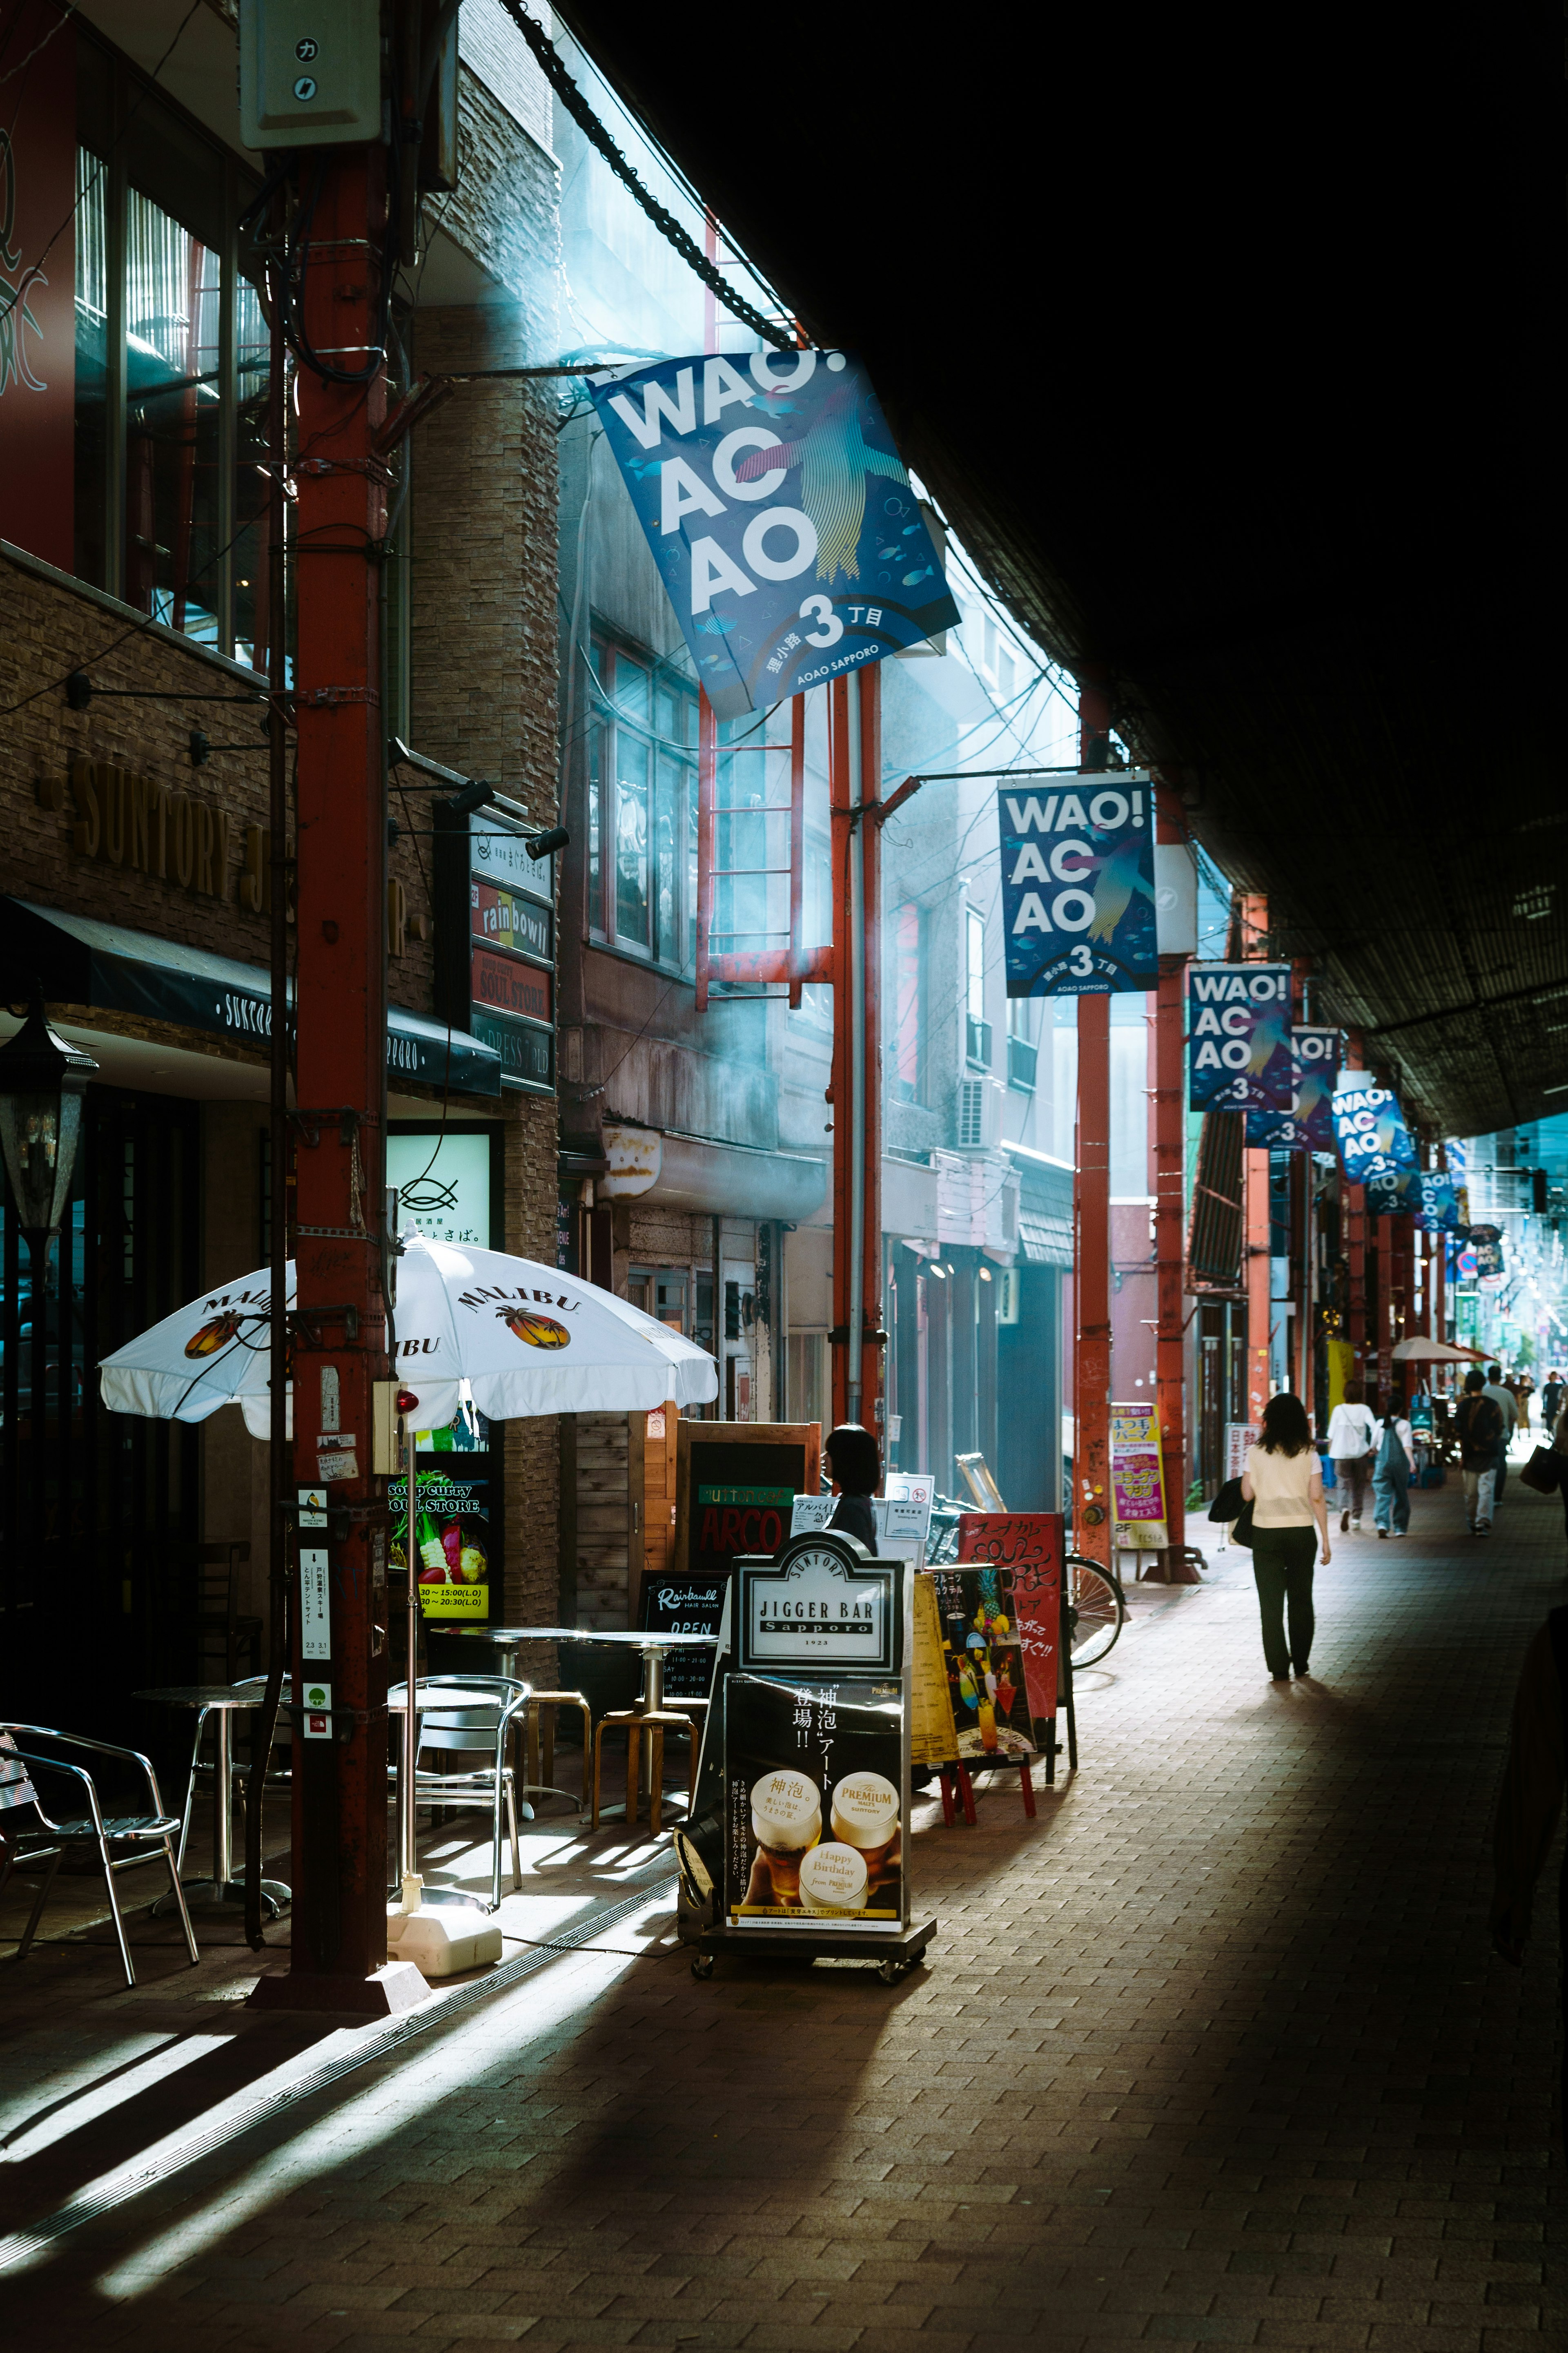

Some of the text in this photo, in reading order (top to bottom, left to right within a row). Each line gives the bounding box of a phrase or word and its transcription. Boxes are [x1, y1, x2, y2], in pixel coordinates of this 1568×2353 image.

[691, 506, 818, 616] AO
[797, 644, 879, 685] AOAO SAPPORO
[1005, 791, 1144, 834] WAO!
[74, 756, 231, 901] SUNTORY
[1012, 889, 1096, 934] AO
[481, 970, 544, 1016] SOUL STORE
[1194, 975, 1287, 1002] WAO!
[226, 993, 417, 1071] SUNTOR PPORO
[1194, 1039, 1251, 1070] AO
[1345, 1131, 1382, 1159] AO
[1369, 1175, 1399, 1192] AO
[418, 1229, 478, 1242] とさば。
[458, 1286, 582, 1314] MALIBU
[395, 1337, 441, 1359] IBU
[427, 1485, 472, 1499] curry
[757, 1489, 791, 1505] caf
[425, 1499, 480, 1512] STORE
[699, 1507, 782, 1554] ARCO
[1115, 1523, 1138, 1532] 2F
[970, 1537, 1043, 1563] SOUL
[791, 1554, 843, 1579] SUNTORY
[933, 1574, 962, 1584] フルーツ
[440, 1589, 481, 1598] 15:00(L.O)
[934, 1586, 963, 1595] カクテル
[440, 1599, 481, 1607] 20:30(L.O)
[760, 1601, 872, 1618] JIGGER BAR
[670, 1620, 711, 1634] OPEN
[765, 1621, 868, 1633] Sapporo
[769, 1777, 810, 1802] 神泡。
[842, 1787, 892, 1804] PREMIUM
[858, 1784, 879, 1793] The
[766, 1797, 801, 1811] 美しい泡は、
[764, 1806, 796, 1820] うまさの証。
[820, 1849, 853, 1865] Happy
[813, 1861, 855, 1878] Birthday
[810, 1878, 826, 1886] from
[829, 1880, 853, 1888] PREMIUM
